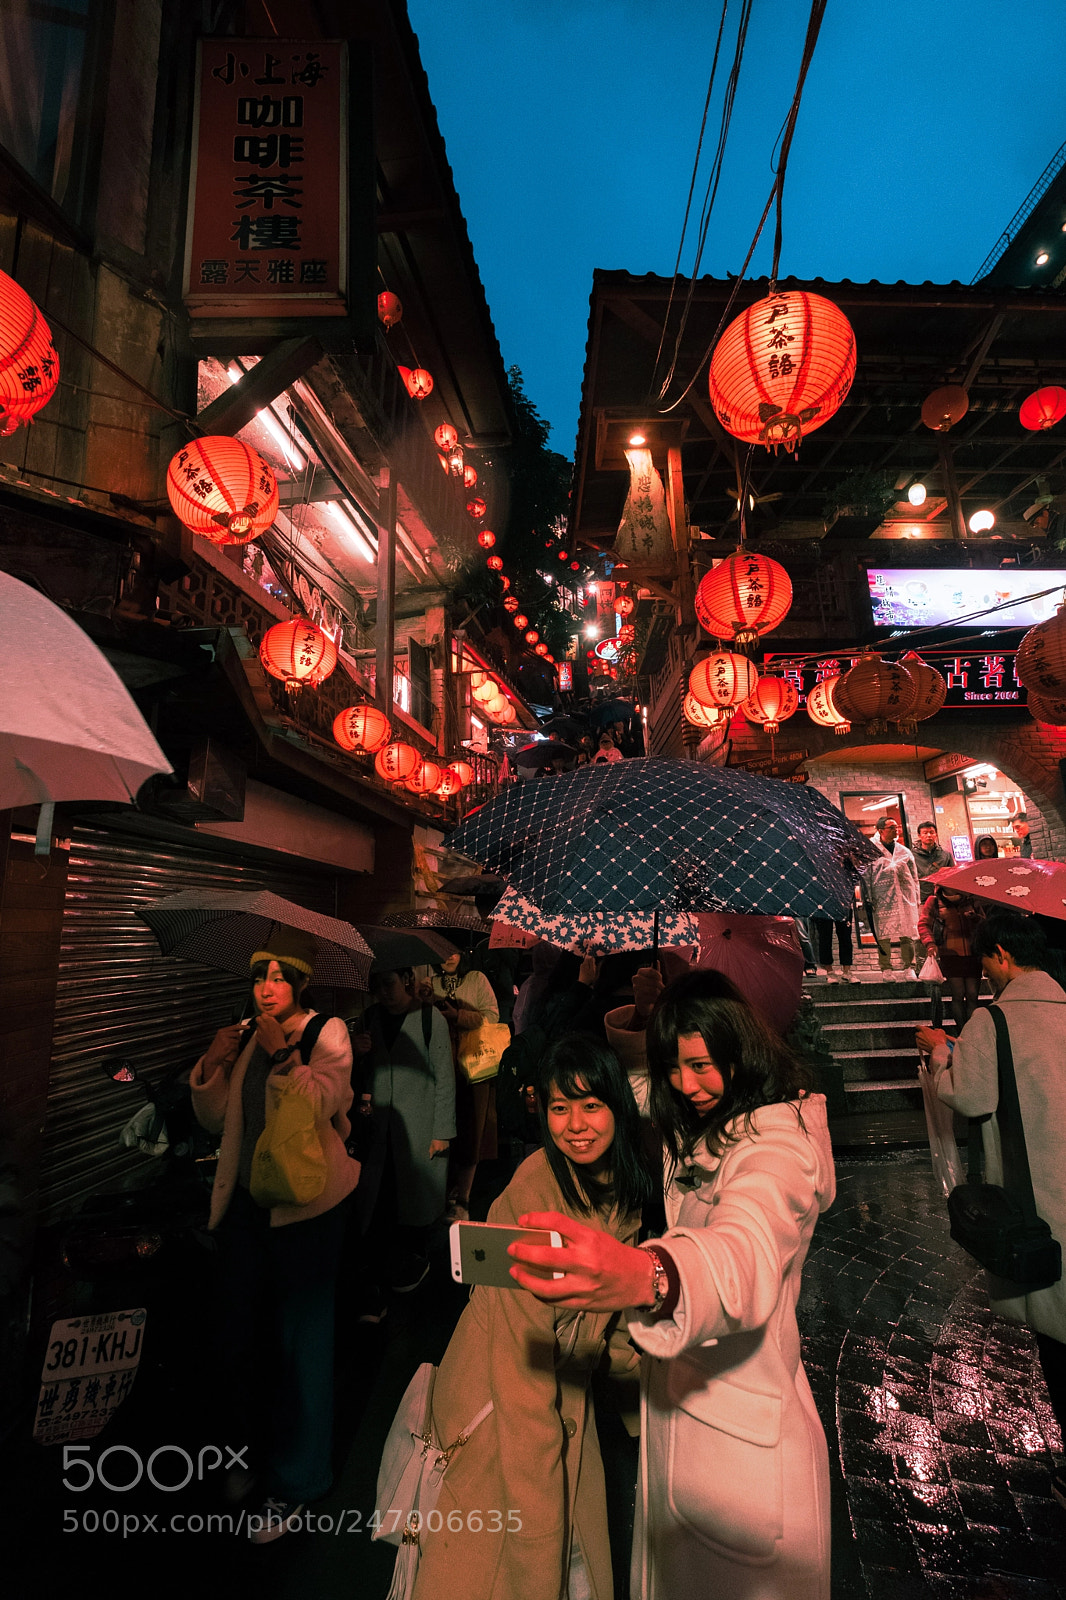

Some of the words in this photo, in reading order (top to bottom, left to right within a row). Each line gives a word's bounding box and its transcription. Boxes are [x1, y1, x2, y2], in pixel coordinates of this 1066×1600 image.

[212, 53, 329, 87] 小上海
[230, 94, 304, 251] 咖啡茶樓
[200, 259, 328, 285] 露天雅座
[964, 691, 993, 701] Since
